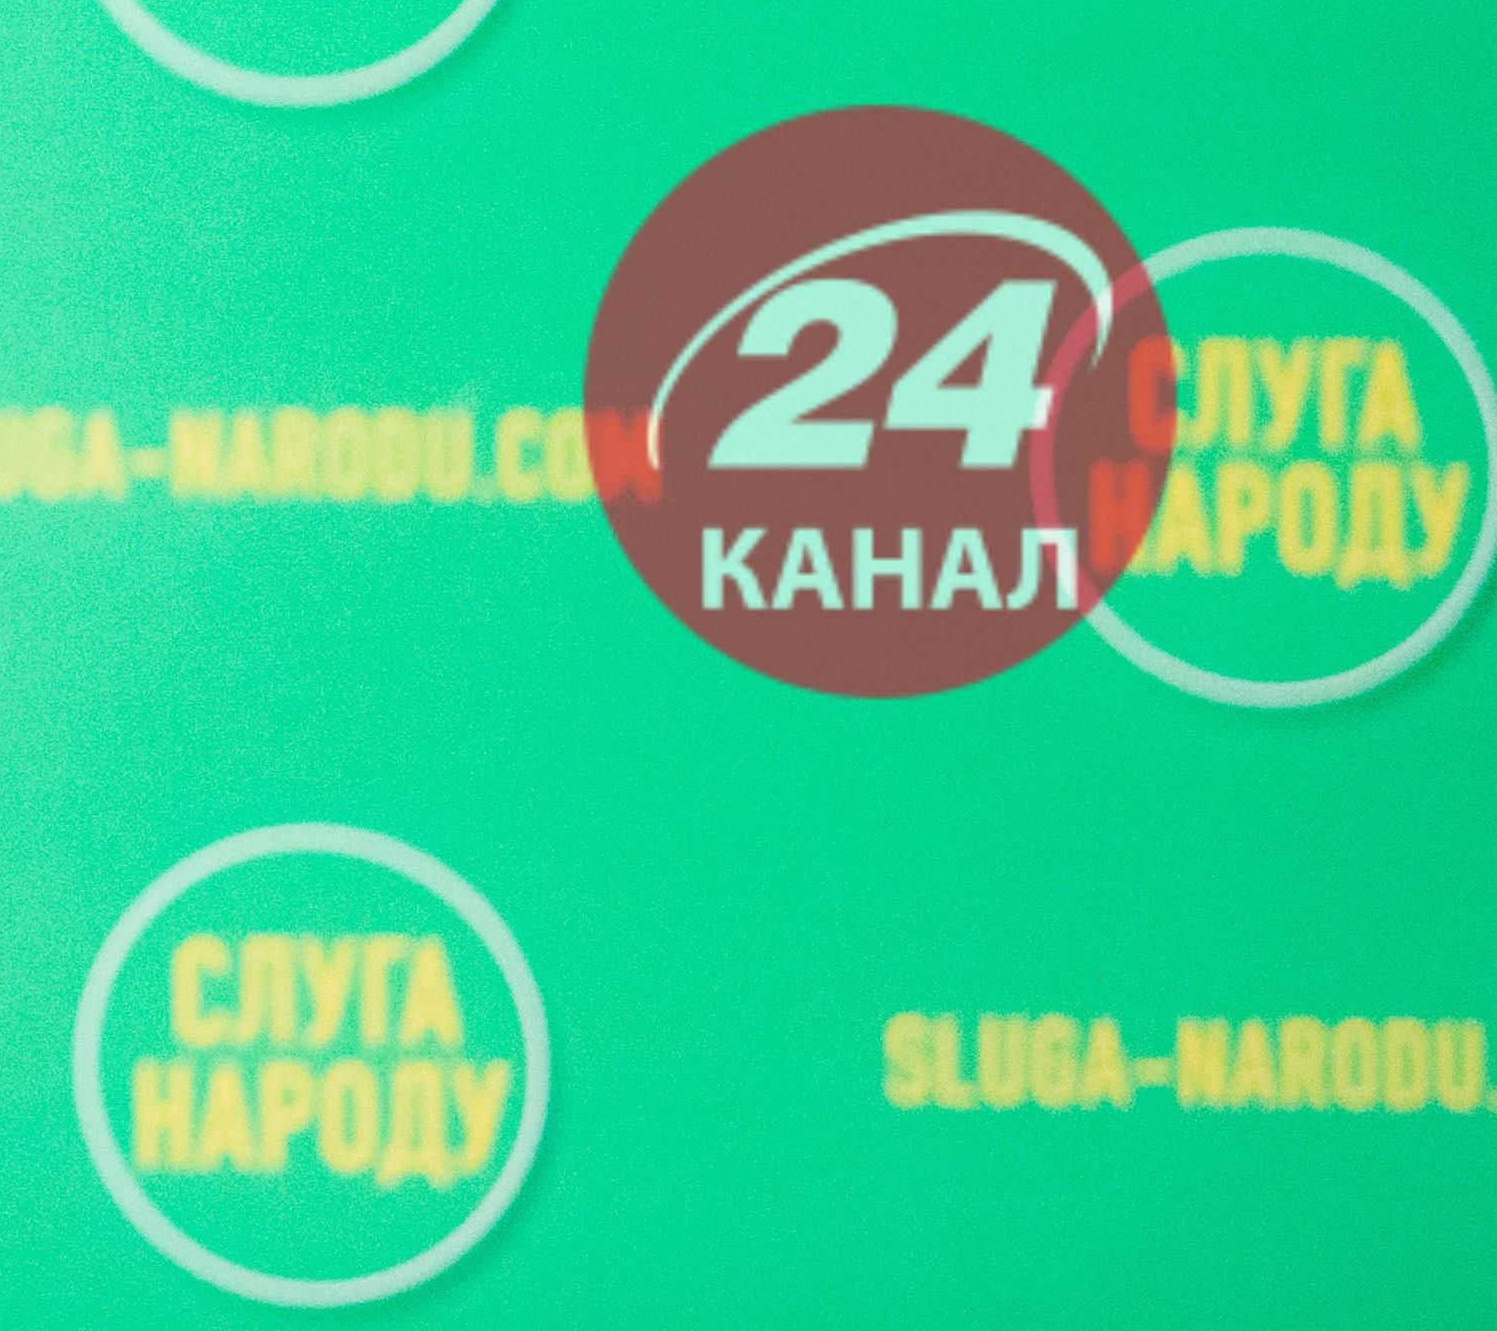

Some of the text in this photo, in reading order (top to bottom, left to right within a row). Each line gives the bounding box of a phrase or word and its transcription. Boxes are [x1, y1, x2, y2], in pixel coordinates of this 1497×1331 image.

[1128, 337, 1422, 450] СЛУГА
[1089, 460, 1467, 590] НАРОДУ
[171, 933, 463, 1047] СЛУГА
[132, 1049, 512, 1181] НАРОДУ
